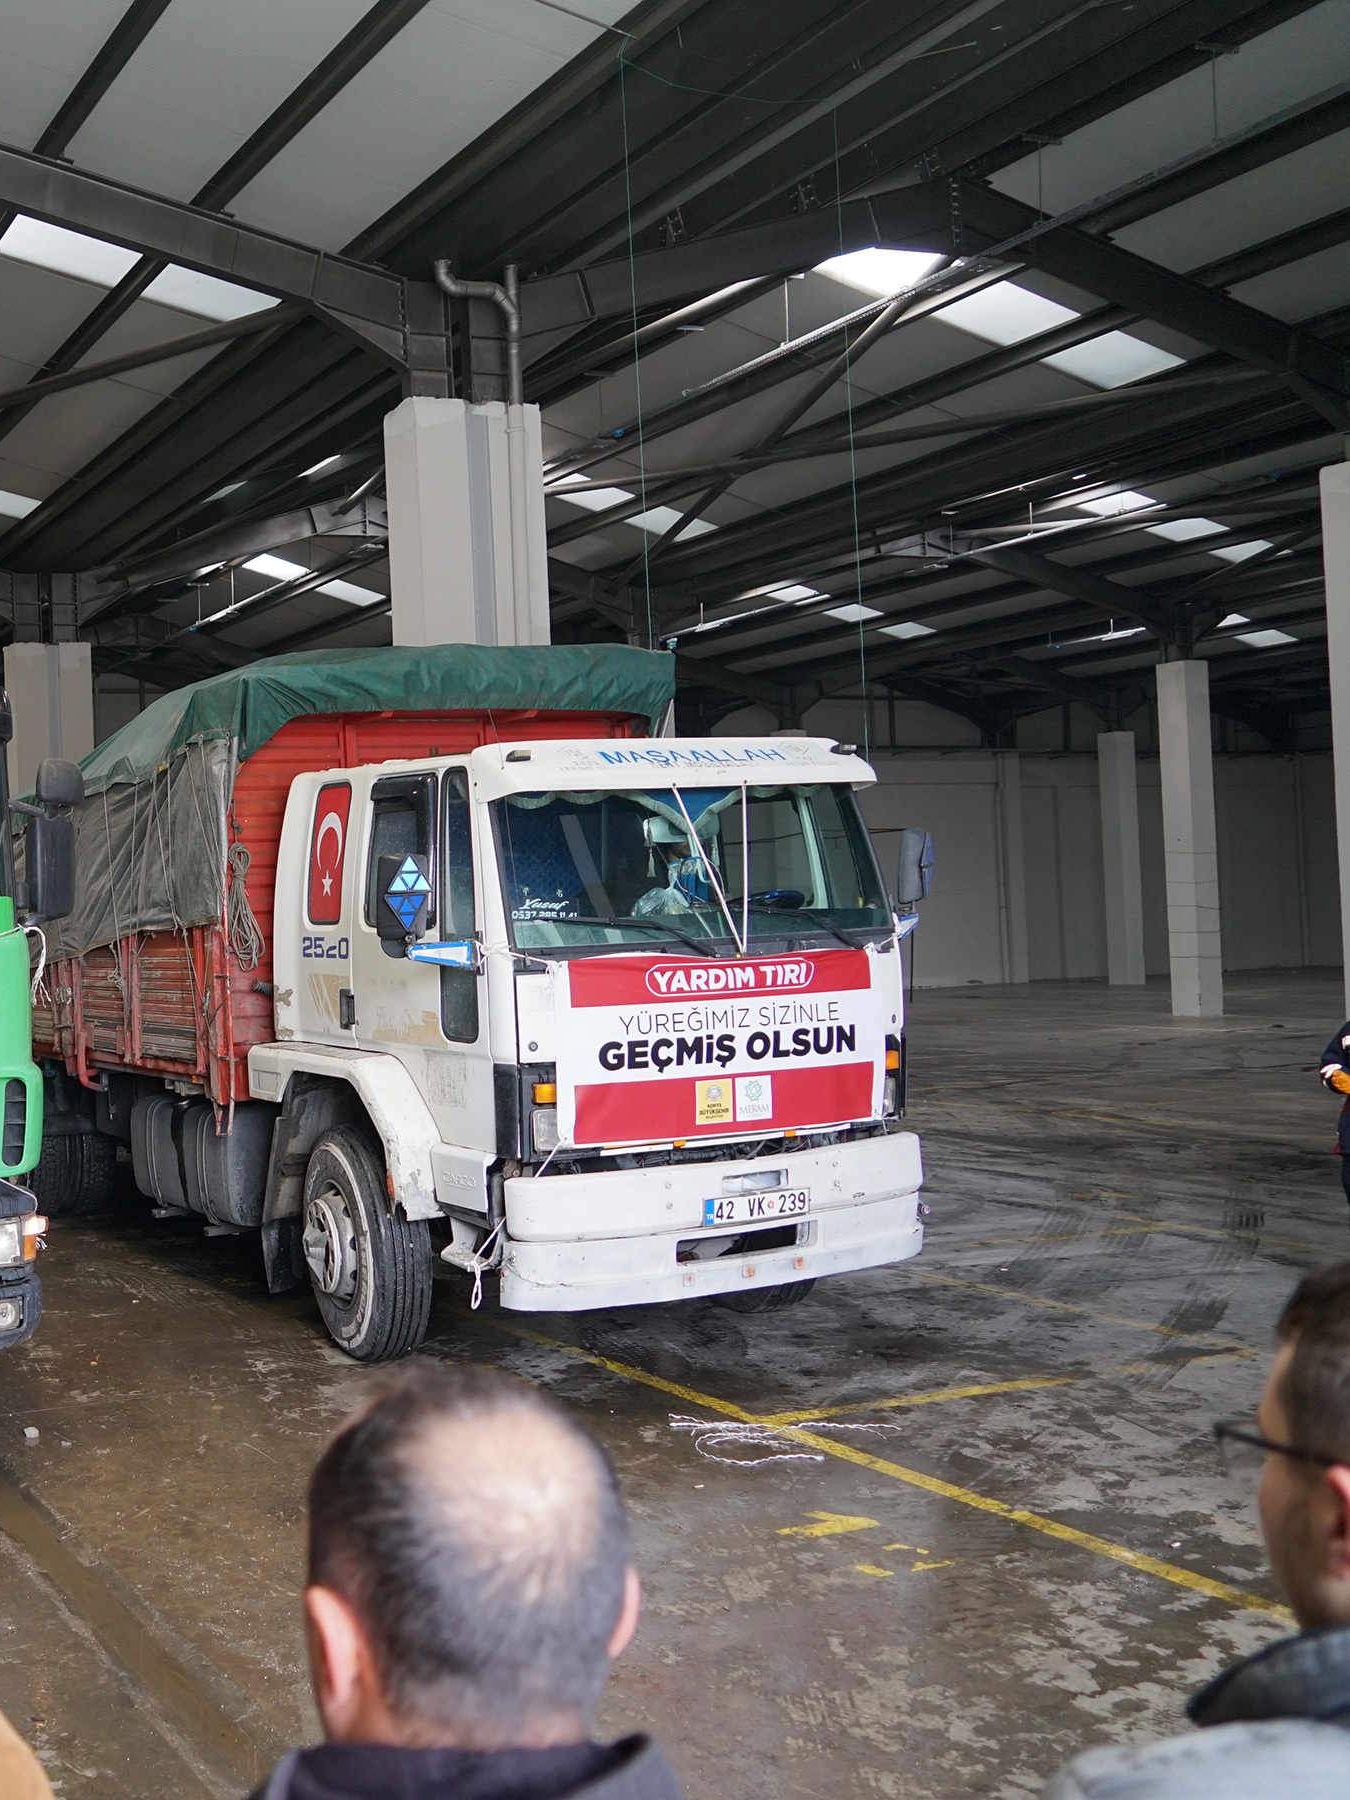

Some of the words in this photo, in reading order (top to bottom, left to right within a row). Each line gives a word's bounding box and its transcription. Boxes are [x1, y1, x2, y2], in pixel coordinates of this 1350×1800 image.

[511, 910, 538, 919] 0537
[519, 898, 570, 910] Yusuf
[653, 966, 755, 993] YARDIM
[760, 962, 807, 985] TIRI
[619, 1005, 751, 1035] YÜREĞİMİZ
[758, 1000, 840, 1027] SİZİNLE
[746, 1024, 856, 1060] OLSUN
[739, 1104, 770, 1114] MERAM
[442, 1170, 477, 1188] CARGO
[716, 1201, 735, 1220] 42
[748, 1197, 766, 1217] VK
[778, 1191, 806, 1213] 239
